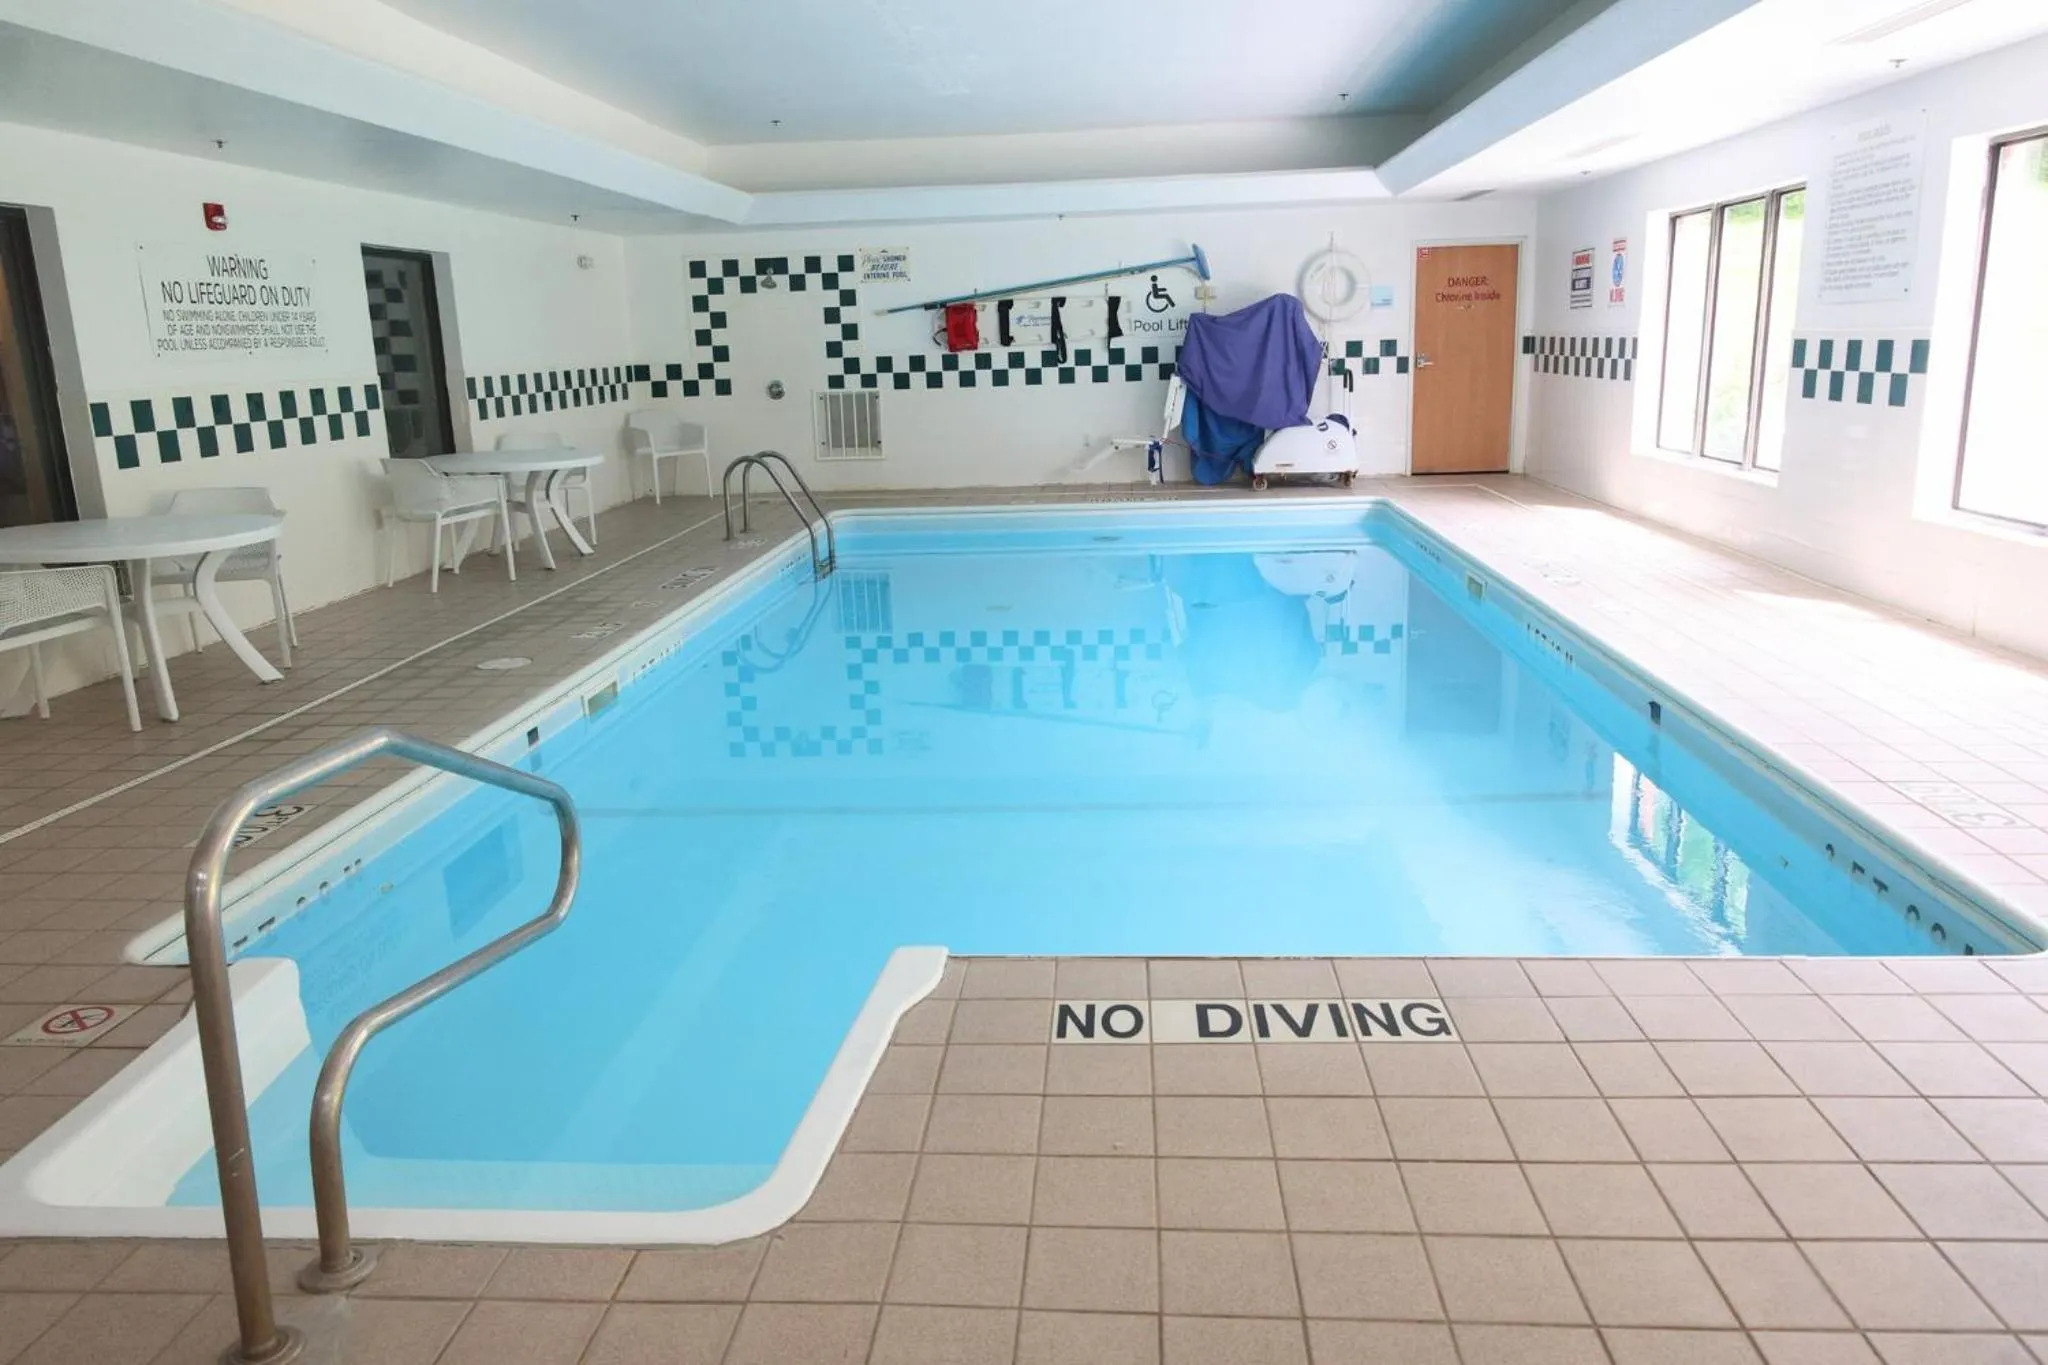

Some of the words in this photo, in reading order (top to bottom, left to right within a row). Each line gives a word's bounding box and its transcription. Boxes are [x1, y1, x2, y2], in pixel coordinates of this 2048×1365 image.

[206, 255, 269, 280] WARNING
[161, 281, 184, 304] NO
[187, 282, 257, 306] LIFEGUARD
[260, 285, 280, 306] ON
[281, 286, 311, 307] DUTY
[1435, 291, 1473, 303] Chlorine
[1474, 289, 1501, 302] Inside
[162, 309, 175, 321] NO
[167, 323, 178, 336] OF
[1134, 319, 1163, 332] Pool
[1168, 319, 1189, 332] Lift
[157, 338, 178, 351] POOL
[1056, 1003, 1144, 1039] NO
[1195, 1002, 1452, 1039] DIVING
